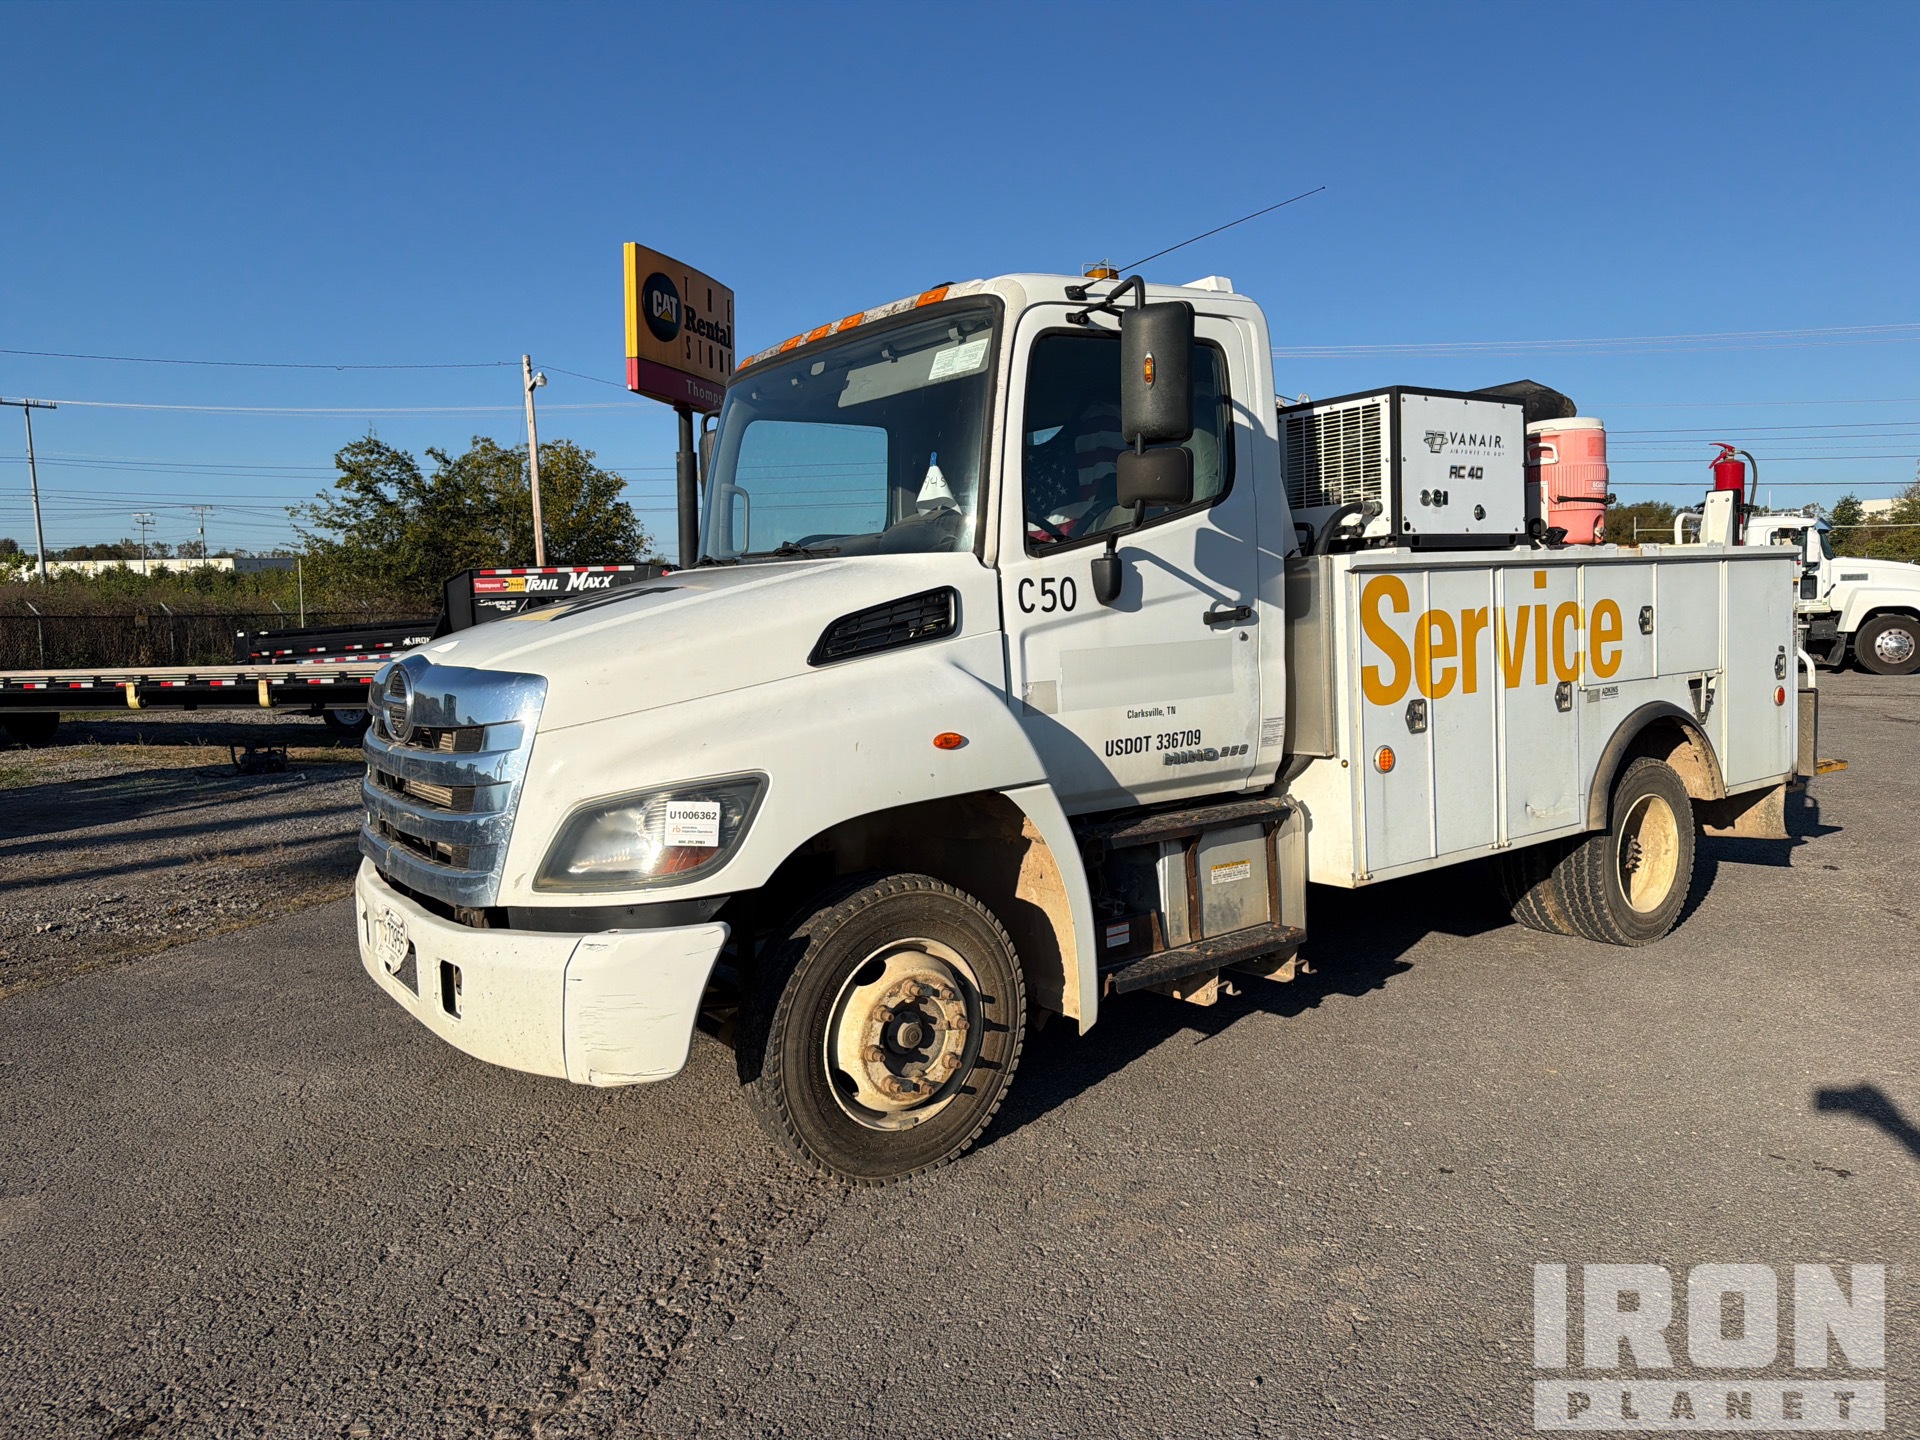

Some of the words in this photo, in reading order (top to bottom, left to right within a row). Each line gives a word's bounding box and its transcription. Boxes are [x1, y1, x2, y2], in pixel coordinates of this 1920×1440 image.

[652, 289, 678, 324] CAT
[684, 304, 732, 349] Rental
[686, 336, 732, 376] STORE
[1468, 466, 1483, 480] 40
[1018, 576, 1077, 613] C50
[1361, 570, 1623, 705] Service
[1127, 707, 1165, 719] Clarksville,
[1167, 705, 1176, 715] TN
[1105, 735, 1152, 757] USDOT
[1156, 729, 1201, 751] 336709
[1163, 747, 1219, 766] HINO
[670, 811, 717, 820] U1006362
